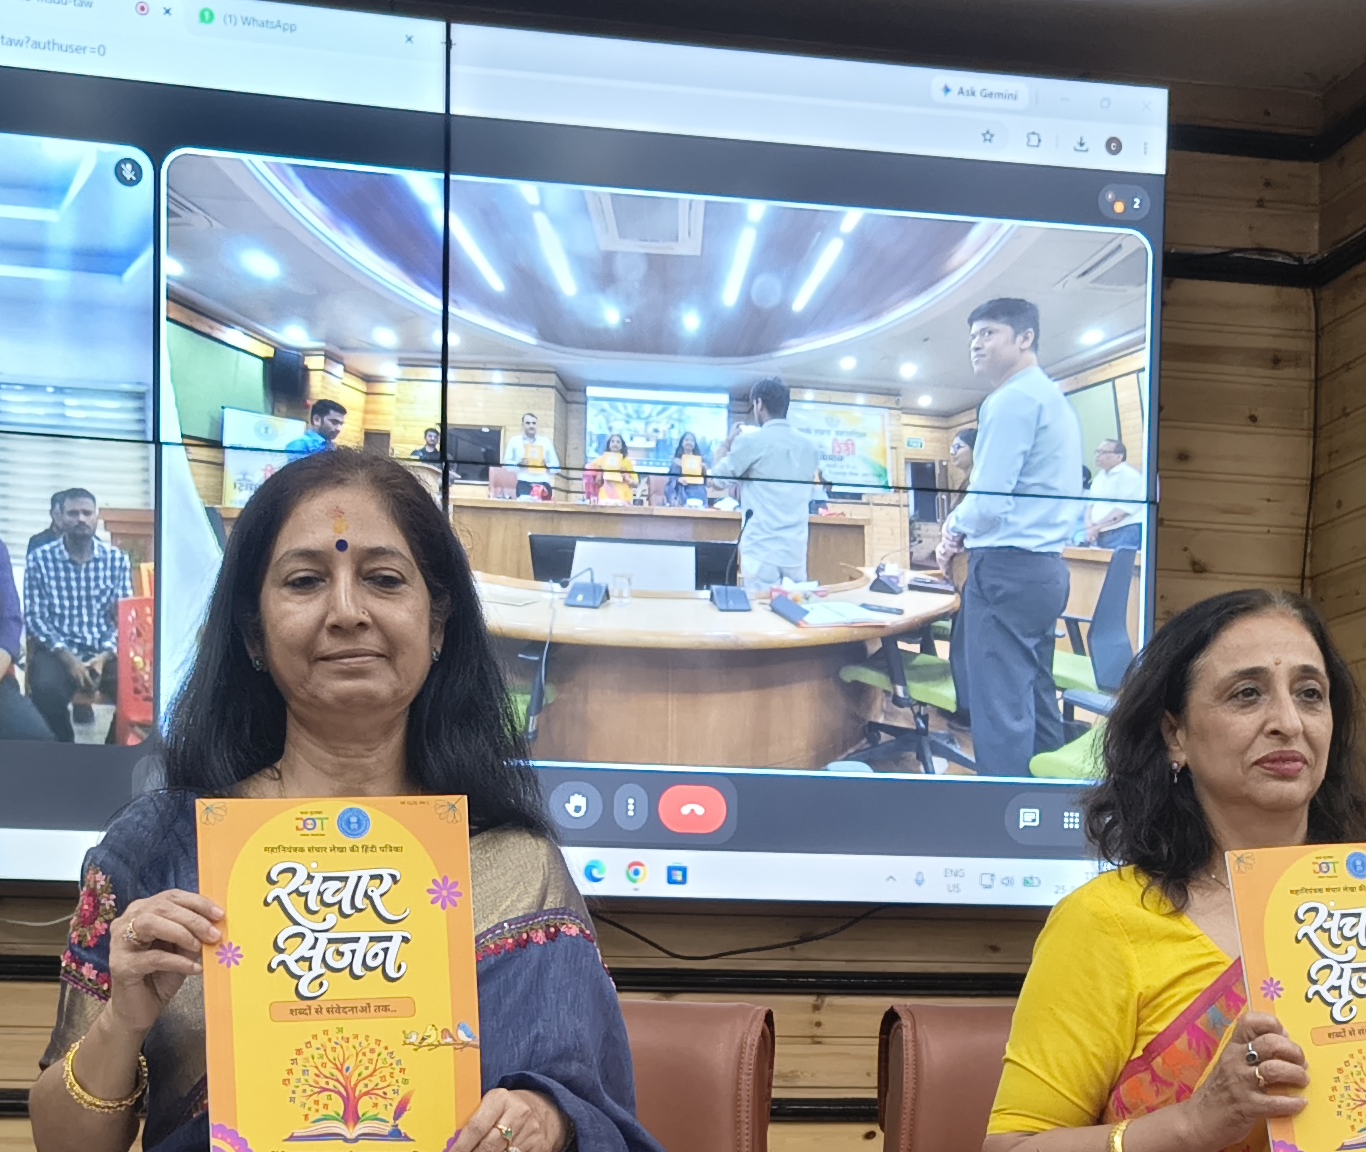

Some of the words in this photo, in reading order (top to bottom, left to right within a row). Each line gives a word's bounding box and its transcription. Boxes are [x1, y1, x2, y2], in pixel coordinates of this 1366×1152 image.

[240, 14, 298, 34] WhatsApp
[957, 86, 976, 98] Ask
[980, 89, 1019, 101] Gemini
[1133, 198, 1141, 209] 2
[263, 862, 410, 932] संचार
[267, 925, 412, 1000] सृजन
